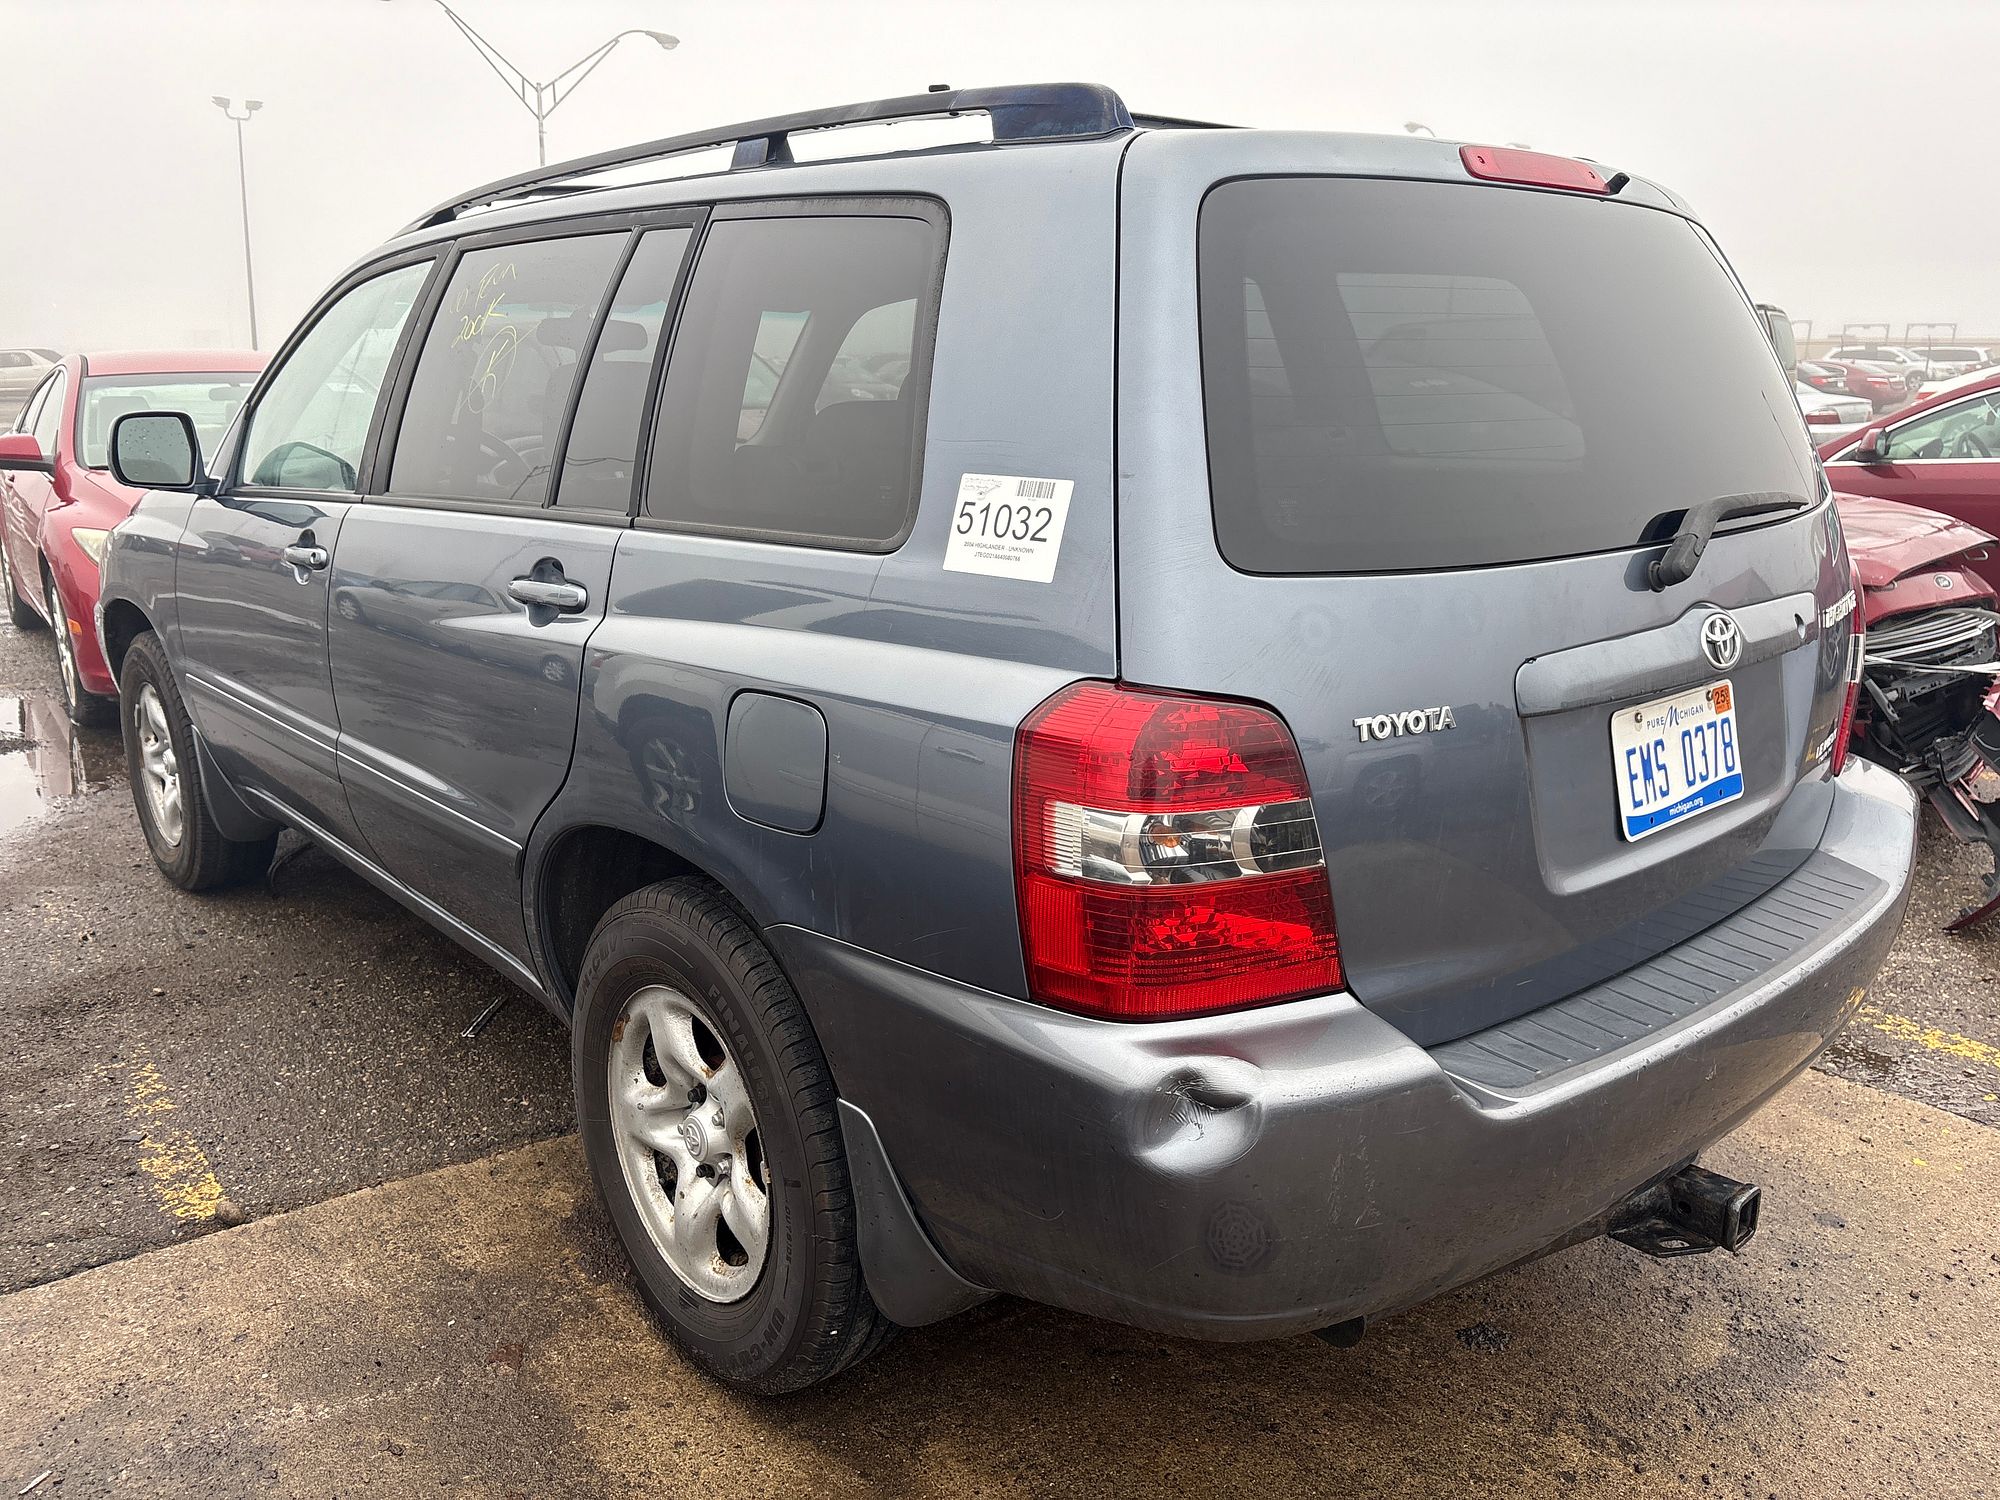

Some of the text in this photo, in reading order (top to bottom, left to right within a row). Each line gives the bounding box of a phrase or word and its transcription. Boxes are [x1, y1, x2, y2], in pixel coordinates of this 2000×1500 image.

[957, 501, 1052, 543] 51032
[975, 542, 1006, 551] HIGHLANDER
[1008, 545, 1035, 554] UNKNOWN
[1714, 689, 1726, 705] 25
[1353, 705, 1457, 742] TOYOTA
[1646, 716, 1665, 730] PURE
[1625, 738, 1670, 810] EMS
[1681, 716, 1736, 788] 0378
[1669, 796, 1705, 817] michigan.org
